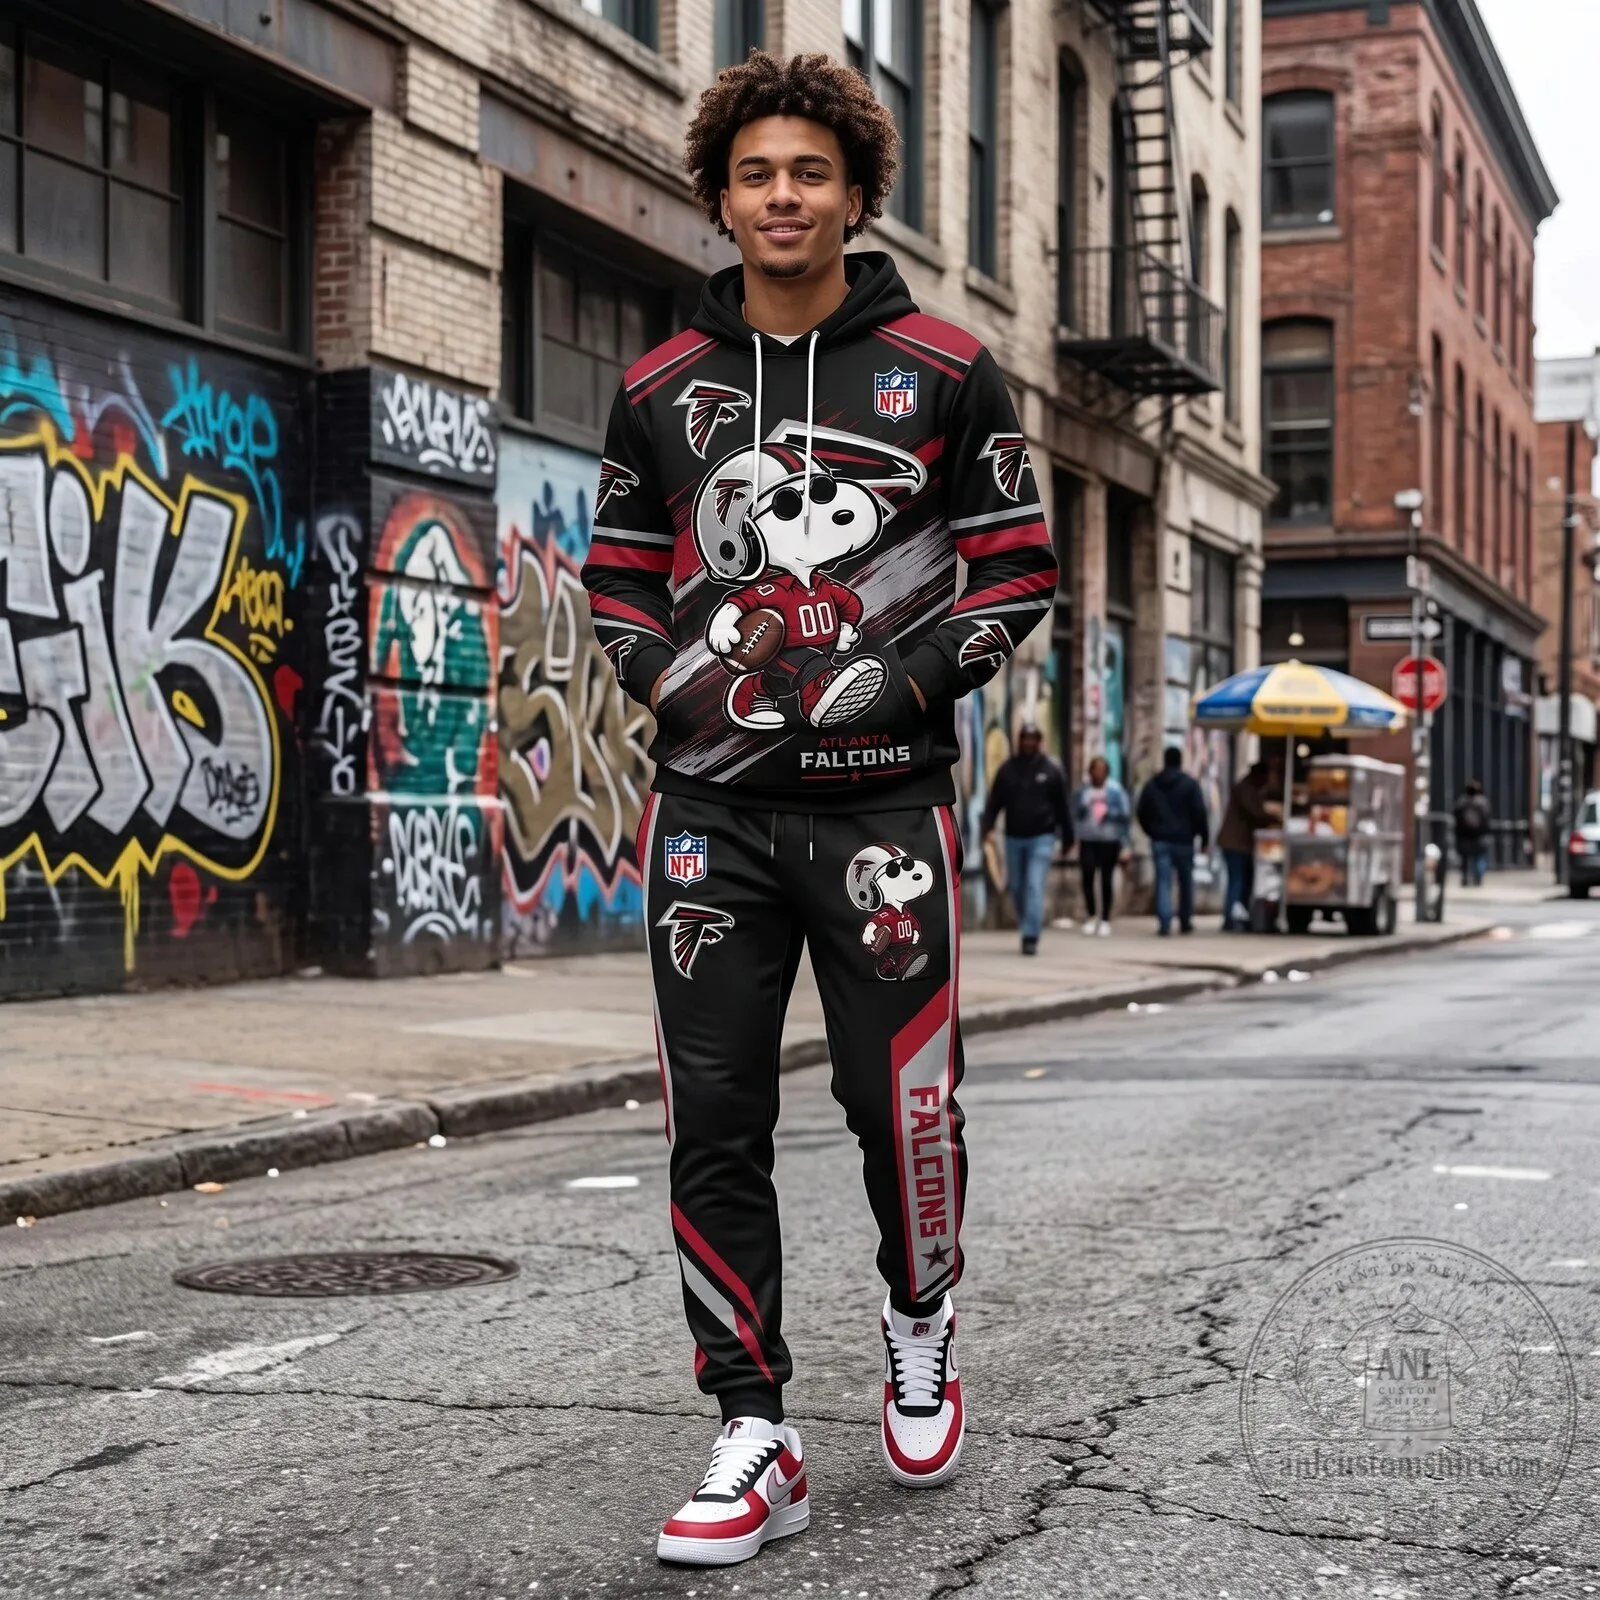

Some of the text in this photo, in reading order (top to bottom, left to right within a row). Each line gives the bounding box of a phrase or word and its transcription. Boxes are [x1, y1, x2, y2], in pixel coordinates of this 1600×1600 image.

[878, 390, 913, 415] NFL
[798, 602, 834, 638] 00
[819, 734, 891, 748] ATLANTA
[800, 745, 911, 769] FALCONS
[669, 855, 703, 880] NFL
[897, 920, 912, 939] 00
[909, 1084, 948, 1239] FALCONS
